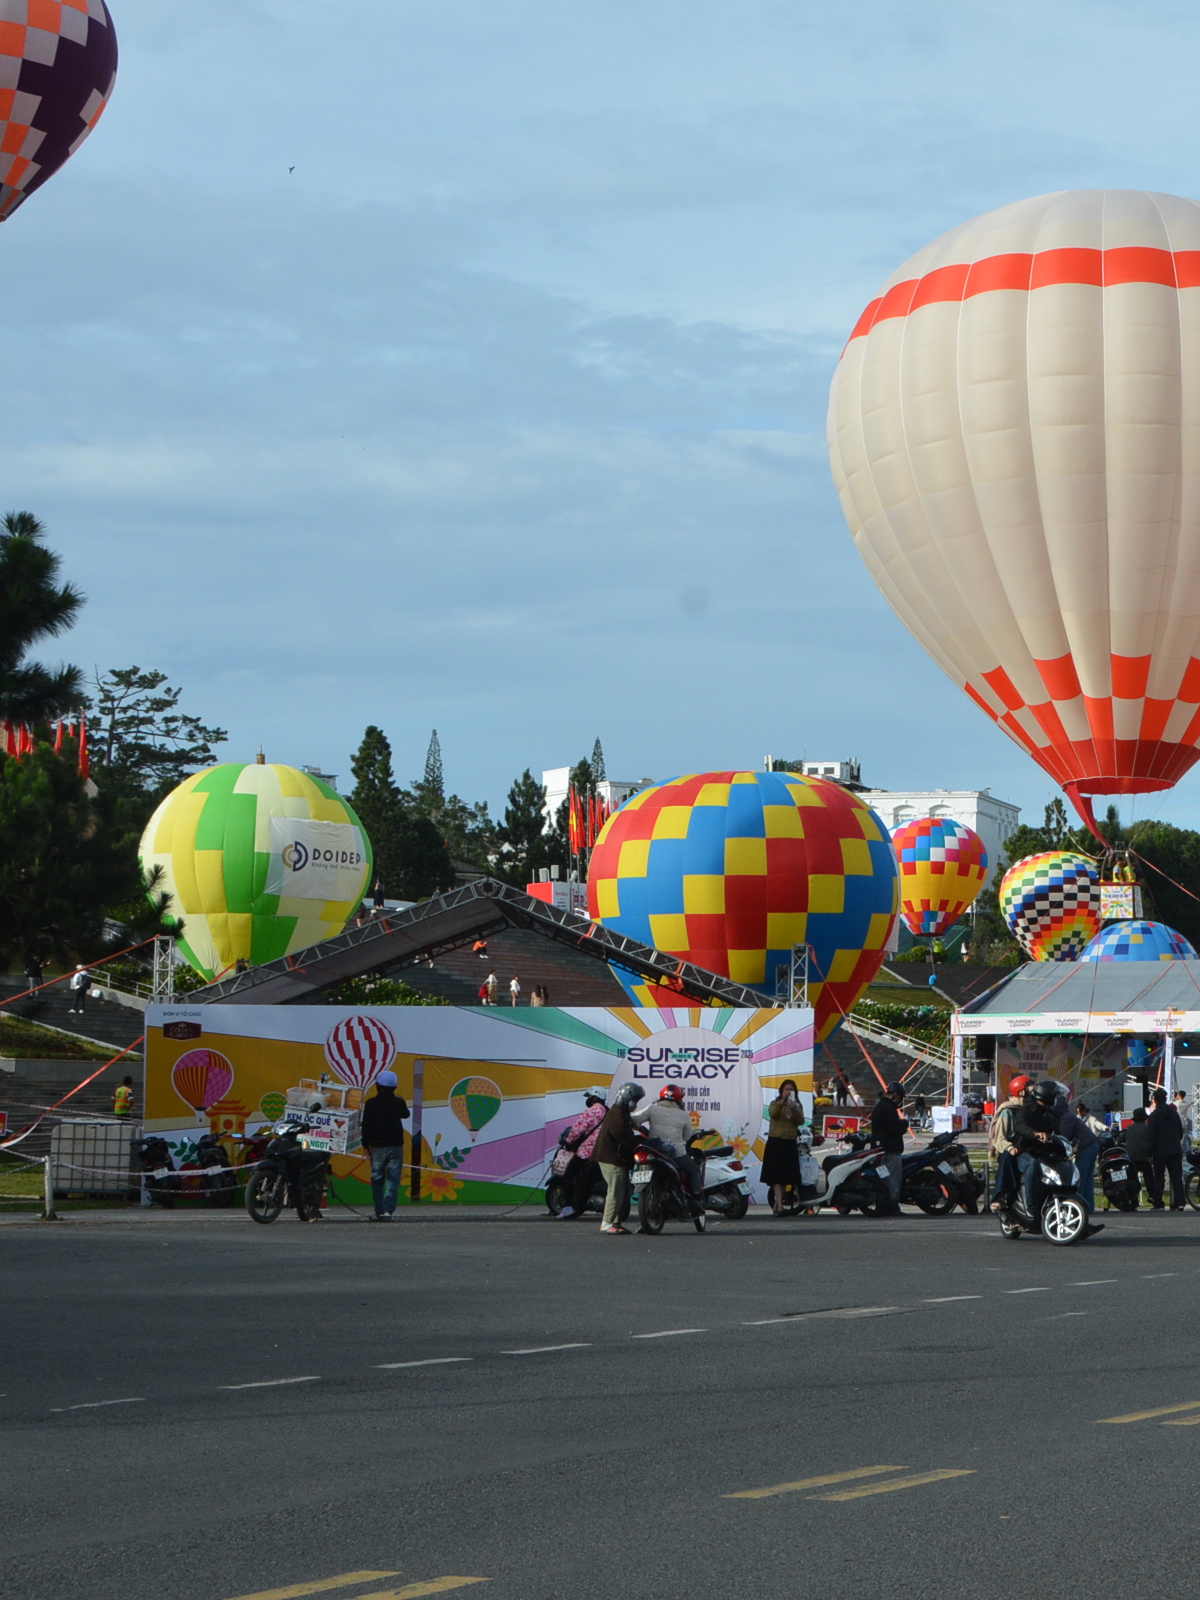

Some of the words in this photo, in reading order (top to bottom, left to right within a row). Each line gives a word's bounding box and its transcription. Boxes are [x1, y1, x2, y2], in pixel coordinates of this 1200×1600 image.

[312, 848, 361, 865] DOIDEP
[617, 1049, 626, 1058] THE
[627, 1047, 740, 1063] SUNRISE
[633, 1064, 736, 1079] LEGACY
